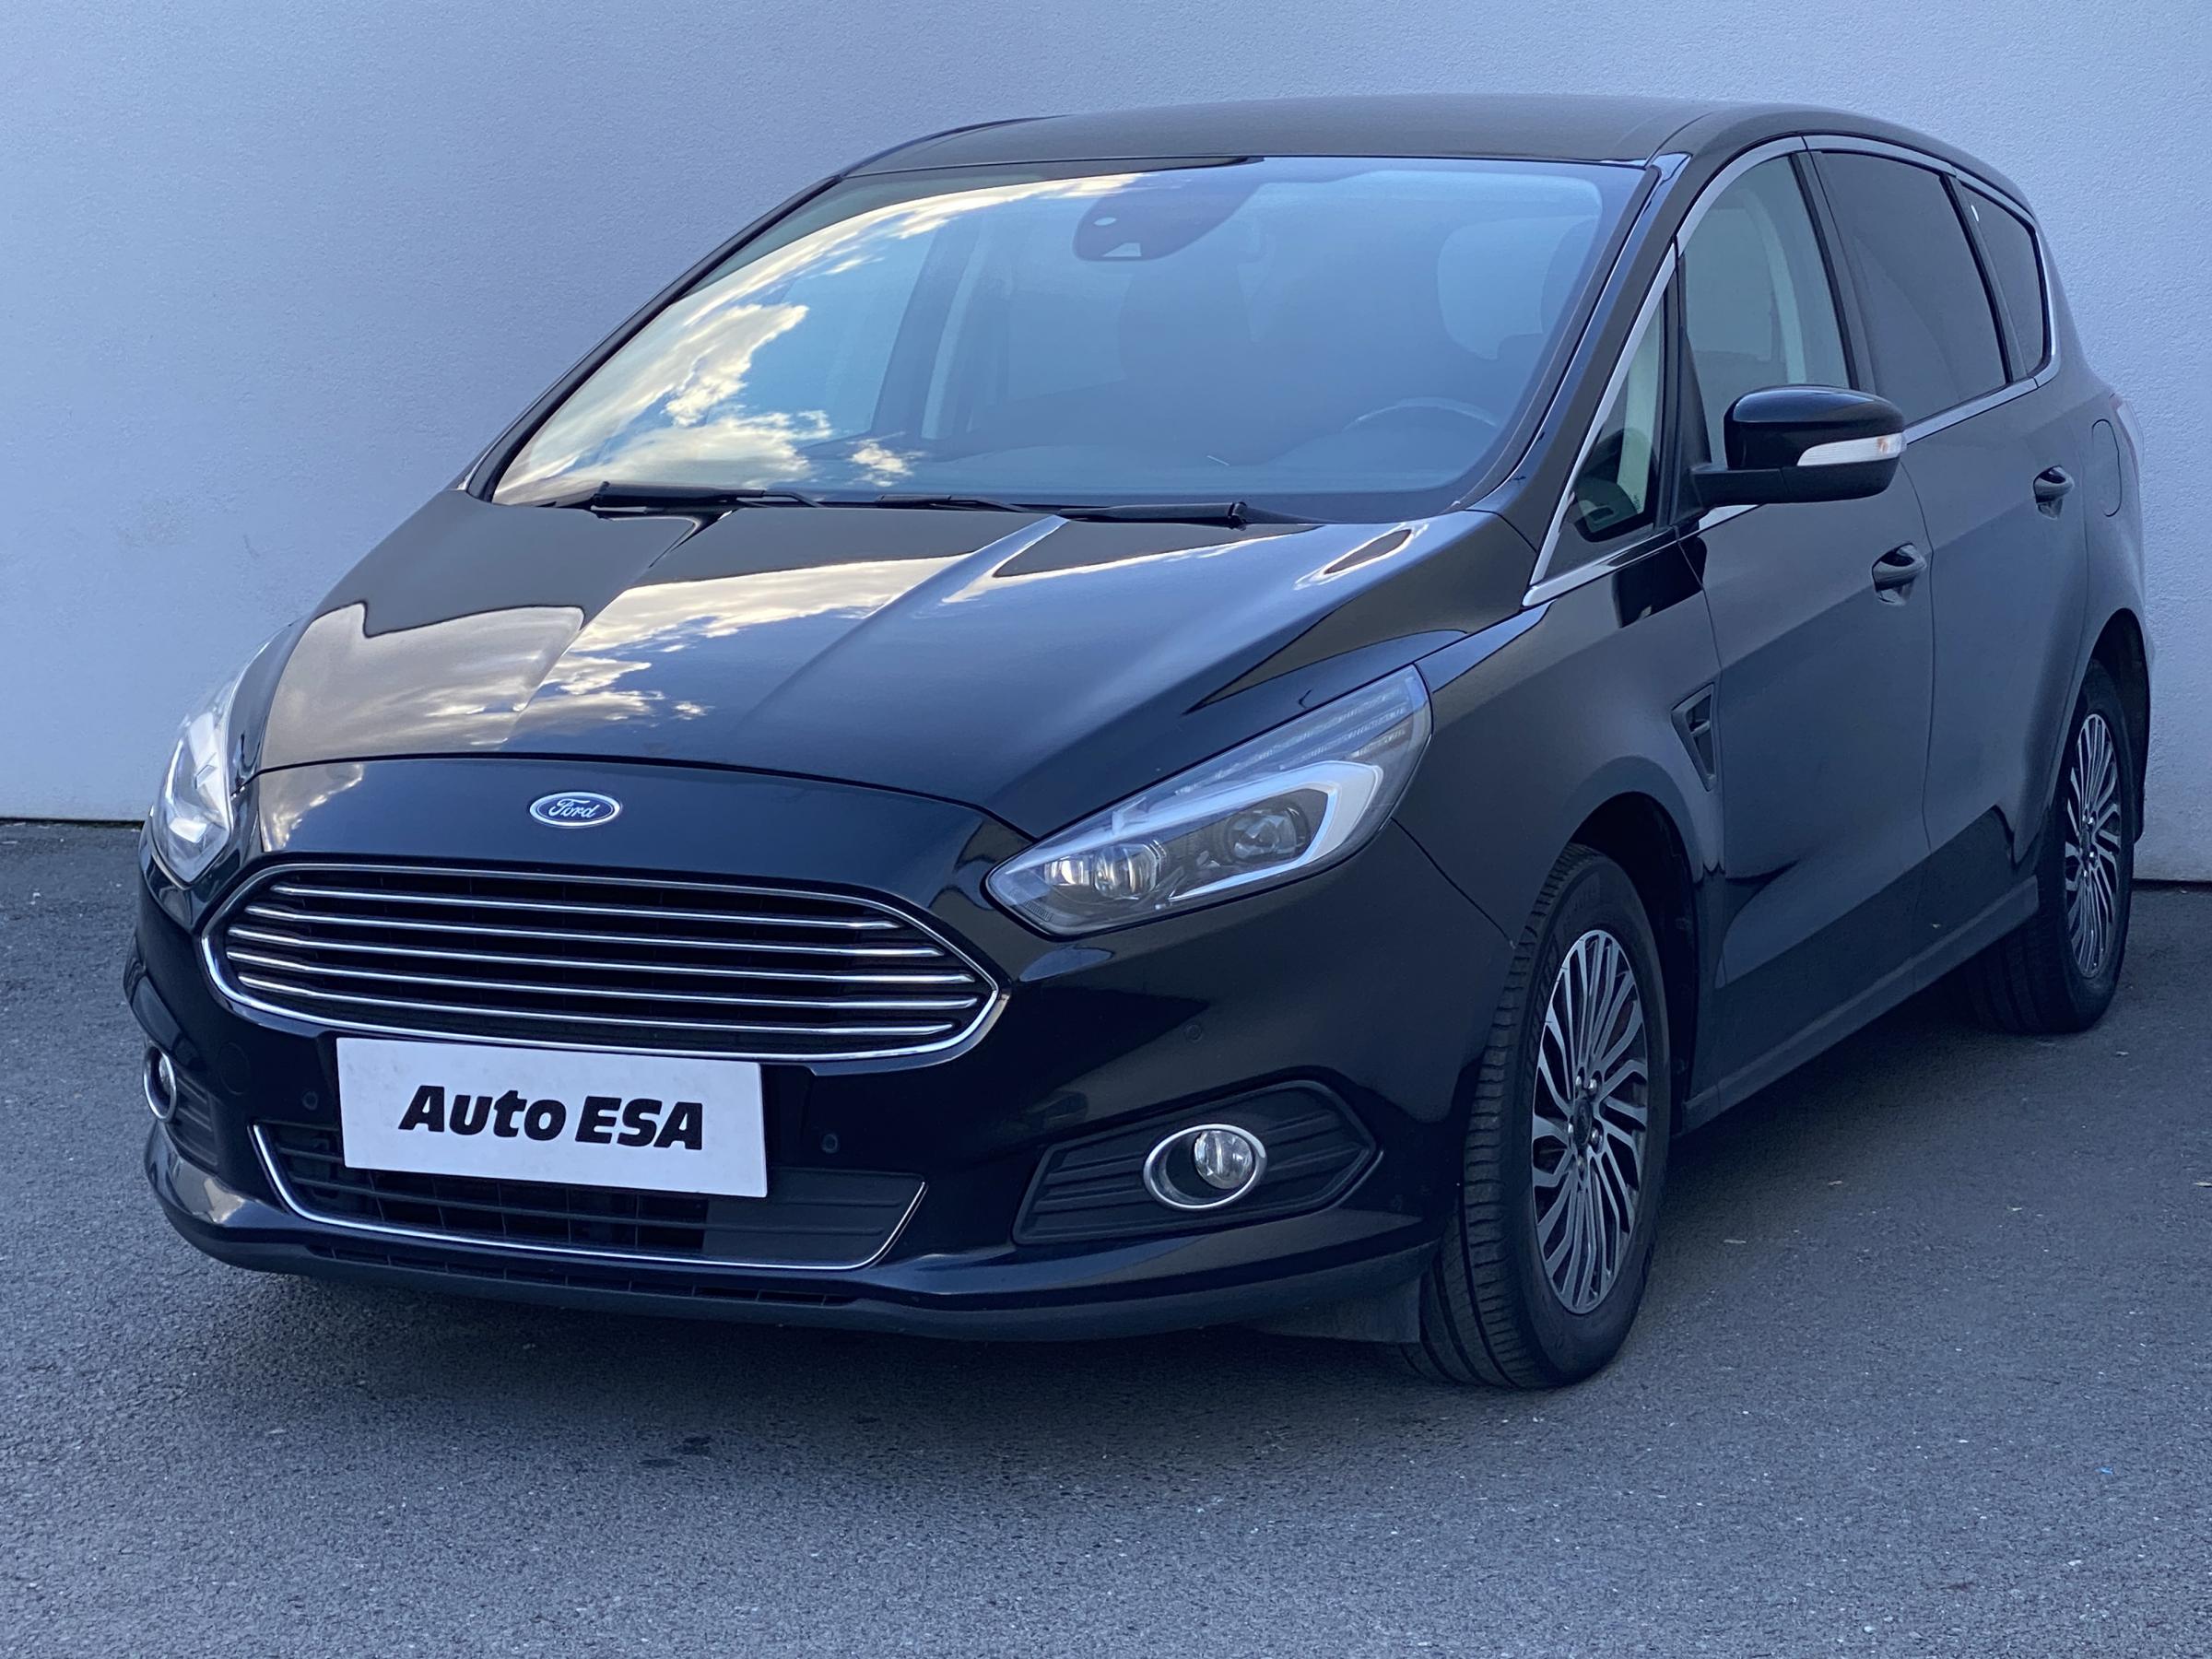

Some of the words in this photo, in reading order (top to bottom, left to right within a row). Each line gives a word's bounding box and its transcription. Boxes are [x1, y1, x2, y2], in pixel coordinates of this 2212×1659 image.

[548, 799, 600, 818] Ford
[398, 1085, 567, 1141] Auto
[575, 1096, 703, 1150] ESA
